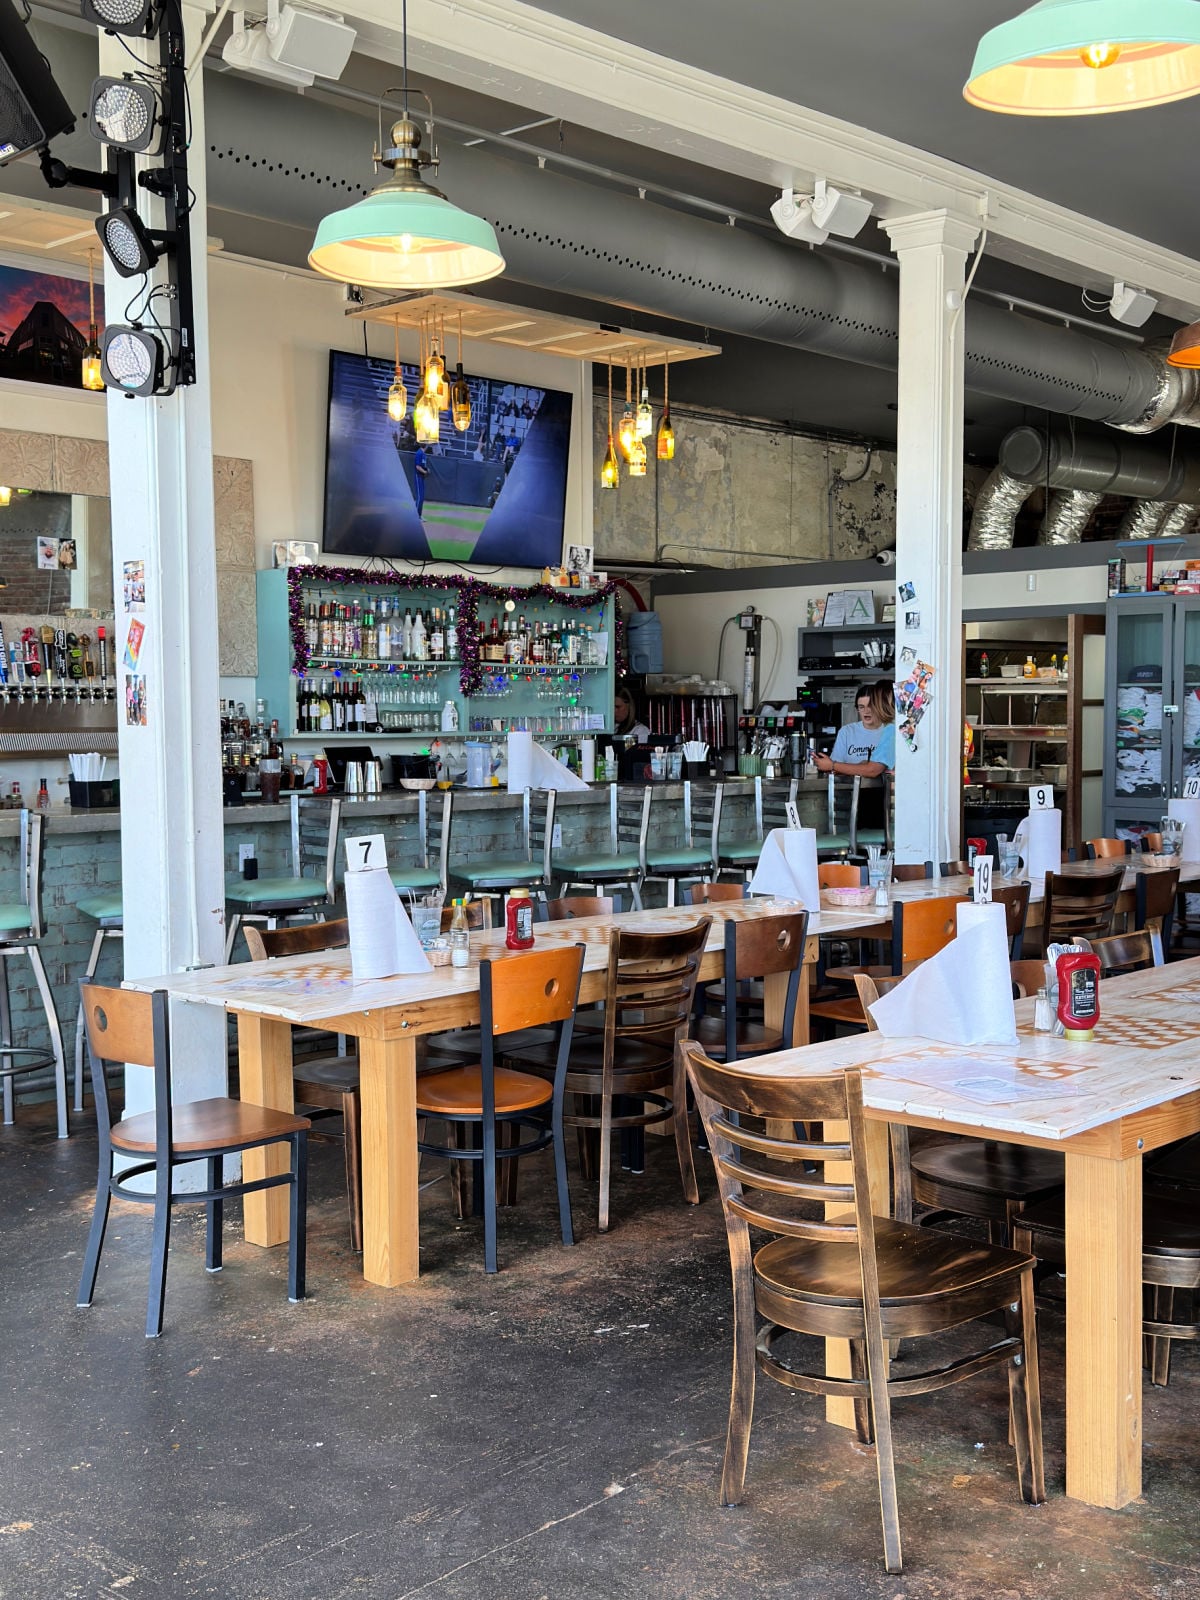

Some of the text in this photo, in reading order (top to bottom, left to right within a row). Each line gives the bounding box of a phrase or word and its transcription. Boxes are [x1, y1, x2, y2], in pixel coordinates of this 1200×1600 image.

[849, 596, 871, 618] A
[1037, 789, 1046, 806] 9
[1187, 780, 1198, 795] 10
[789, 806, 797, 825] 8
[358, 841, 372, 864] 7
[977, 862, 990, 894] 19
